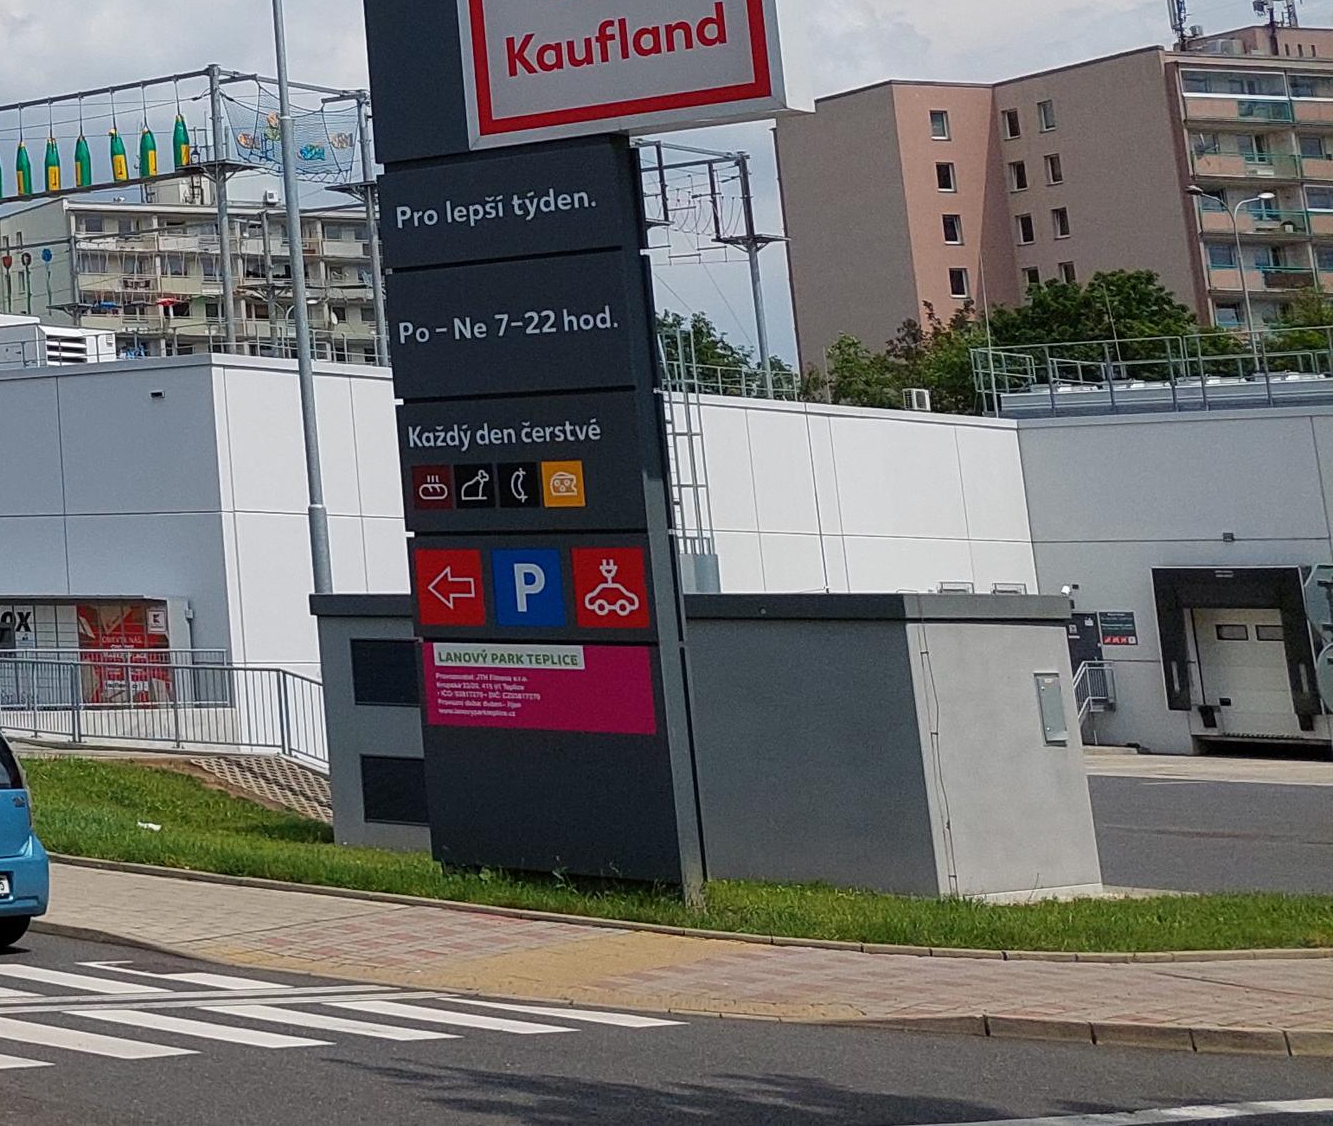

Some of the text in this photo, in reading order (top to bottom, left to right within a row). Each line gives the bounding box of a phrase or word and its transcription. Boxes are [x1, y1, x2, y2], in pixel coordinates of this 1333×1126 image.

[505, 1, 727, 77] Kaufland
[396, 188, 597, 229] Pro lepší týden.
[399, 322, 430, 344] Po
[453, 317, 487, 340] Ne
[562, 305, 619, 332] hod.
[408, 418, 602, 452] Každý den čerstvé
[513, 562, 546, 613] P
[438, 649, 579, 666] LANOVÝ PARK TEPLICE
